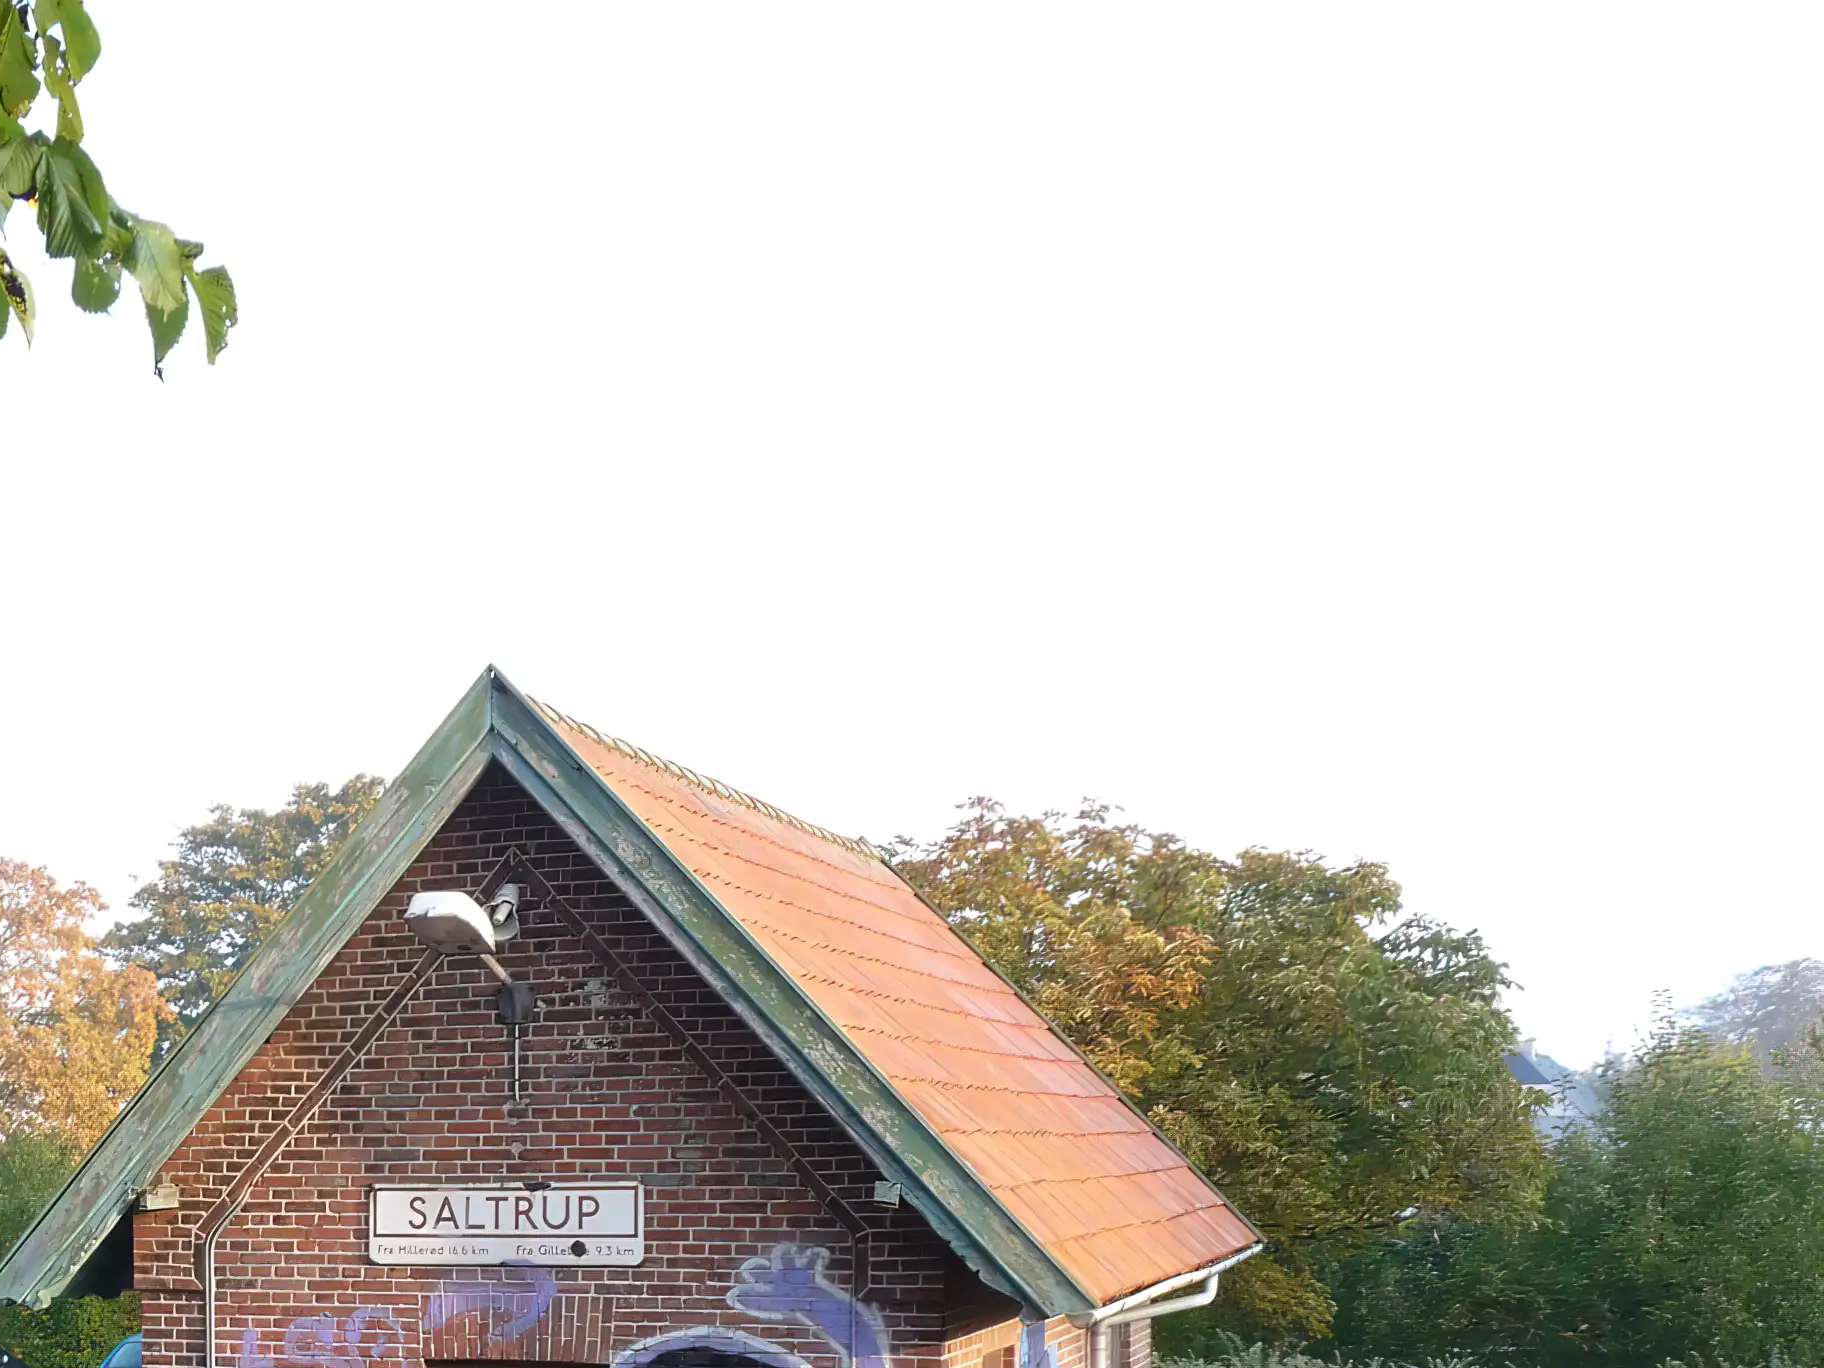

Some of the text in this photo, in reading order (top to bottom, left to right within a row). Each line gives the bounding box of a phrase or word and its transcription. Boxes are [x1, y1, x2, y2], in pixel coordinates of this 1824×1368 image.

[407, 1195, 600, 1231] SALTRUP
[377, 1244, 394, 1255] Fra
[471, 1244, 489, 1255] km
[516, 1244, 533, 1256] Fra
[616, 1245, 635, 1256] km
